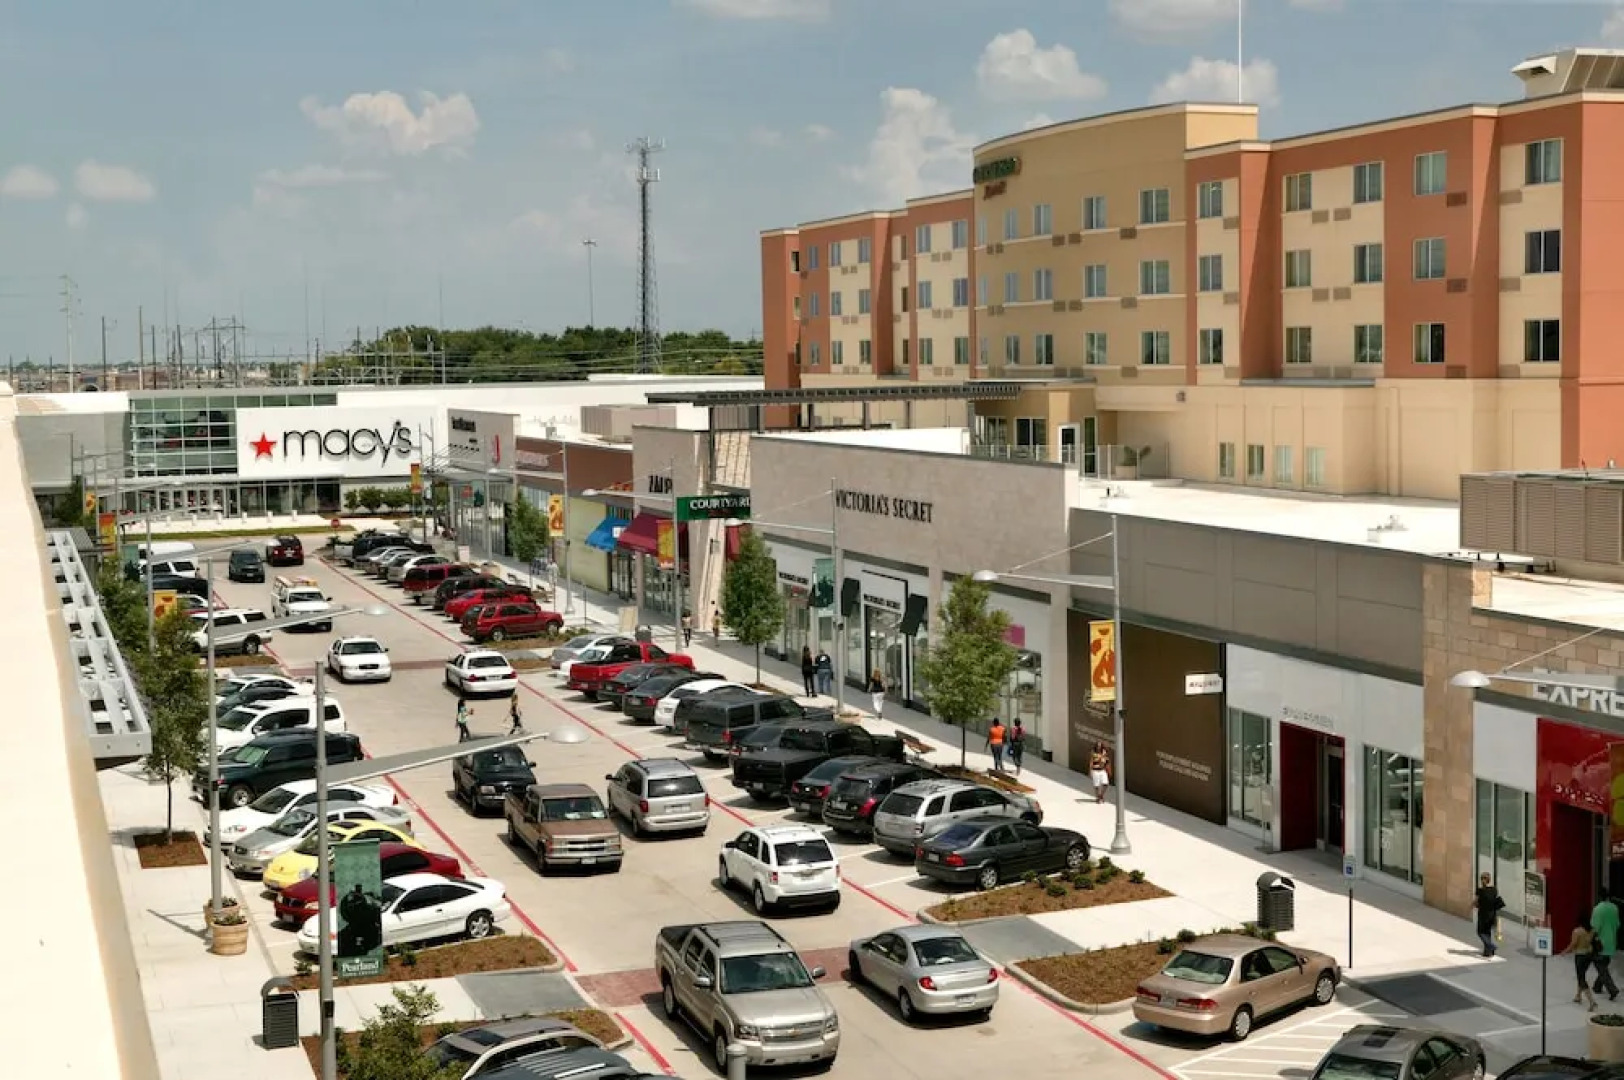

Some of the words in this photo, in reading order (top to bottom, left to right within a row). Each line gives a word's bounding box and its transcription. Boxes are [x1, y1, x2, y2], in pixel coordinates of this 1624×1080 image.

[283, 420, 412, 468] macy's
[835, 490, 889, 516] VICTORIA'S
[892, 497, 933, 523] SECRET
[342, 960, 379, 972] Pearland
